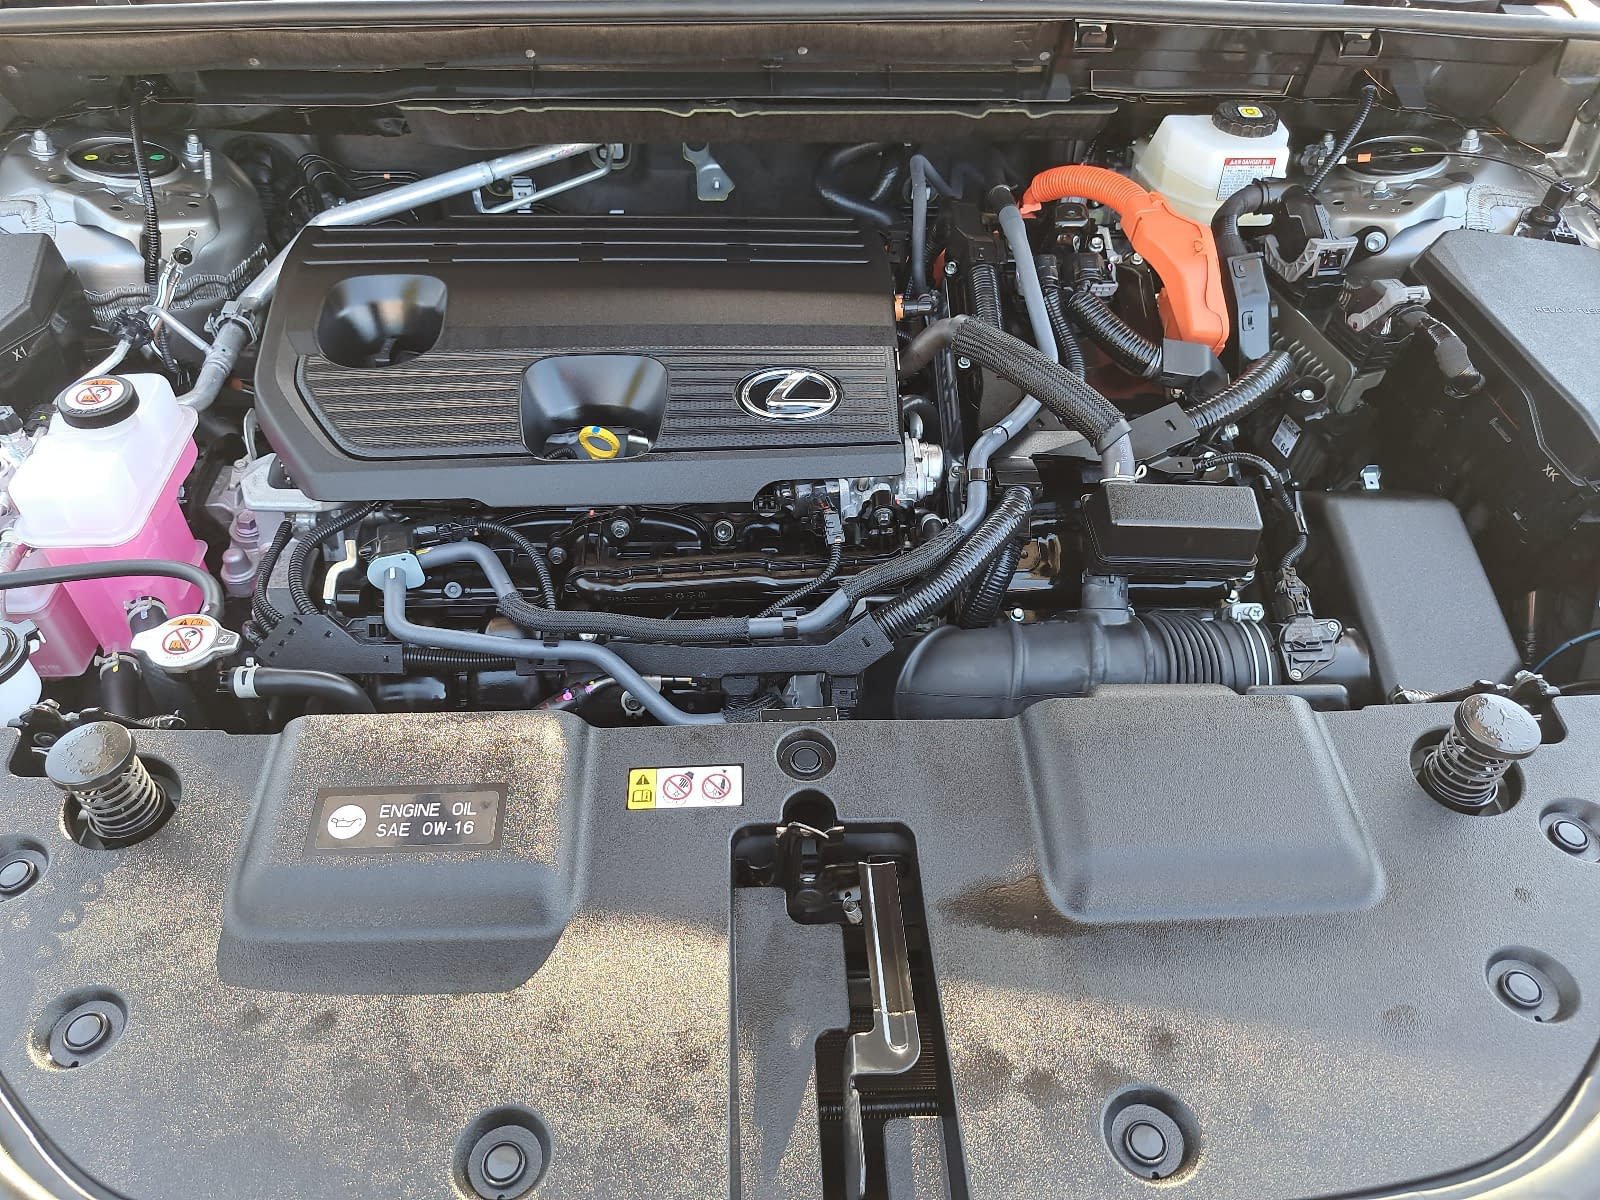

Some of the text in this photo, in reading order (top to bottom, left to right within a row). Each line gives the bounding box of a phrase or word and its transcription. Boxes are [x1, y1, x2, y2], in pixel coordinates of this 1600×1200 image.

[11, 346, 27, 361] X1
[379, 801, 477, 818] ENGINE OIL
[375, 820, 475, 838] SAE 0W-16
